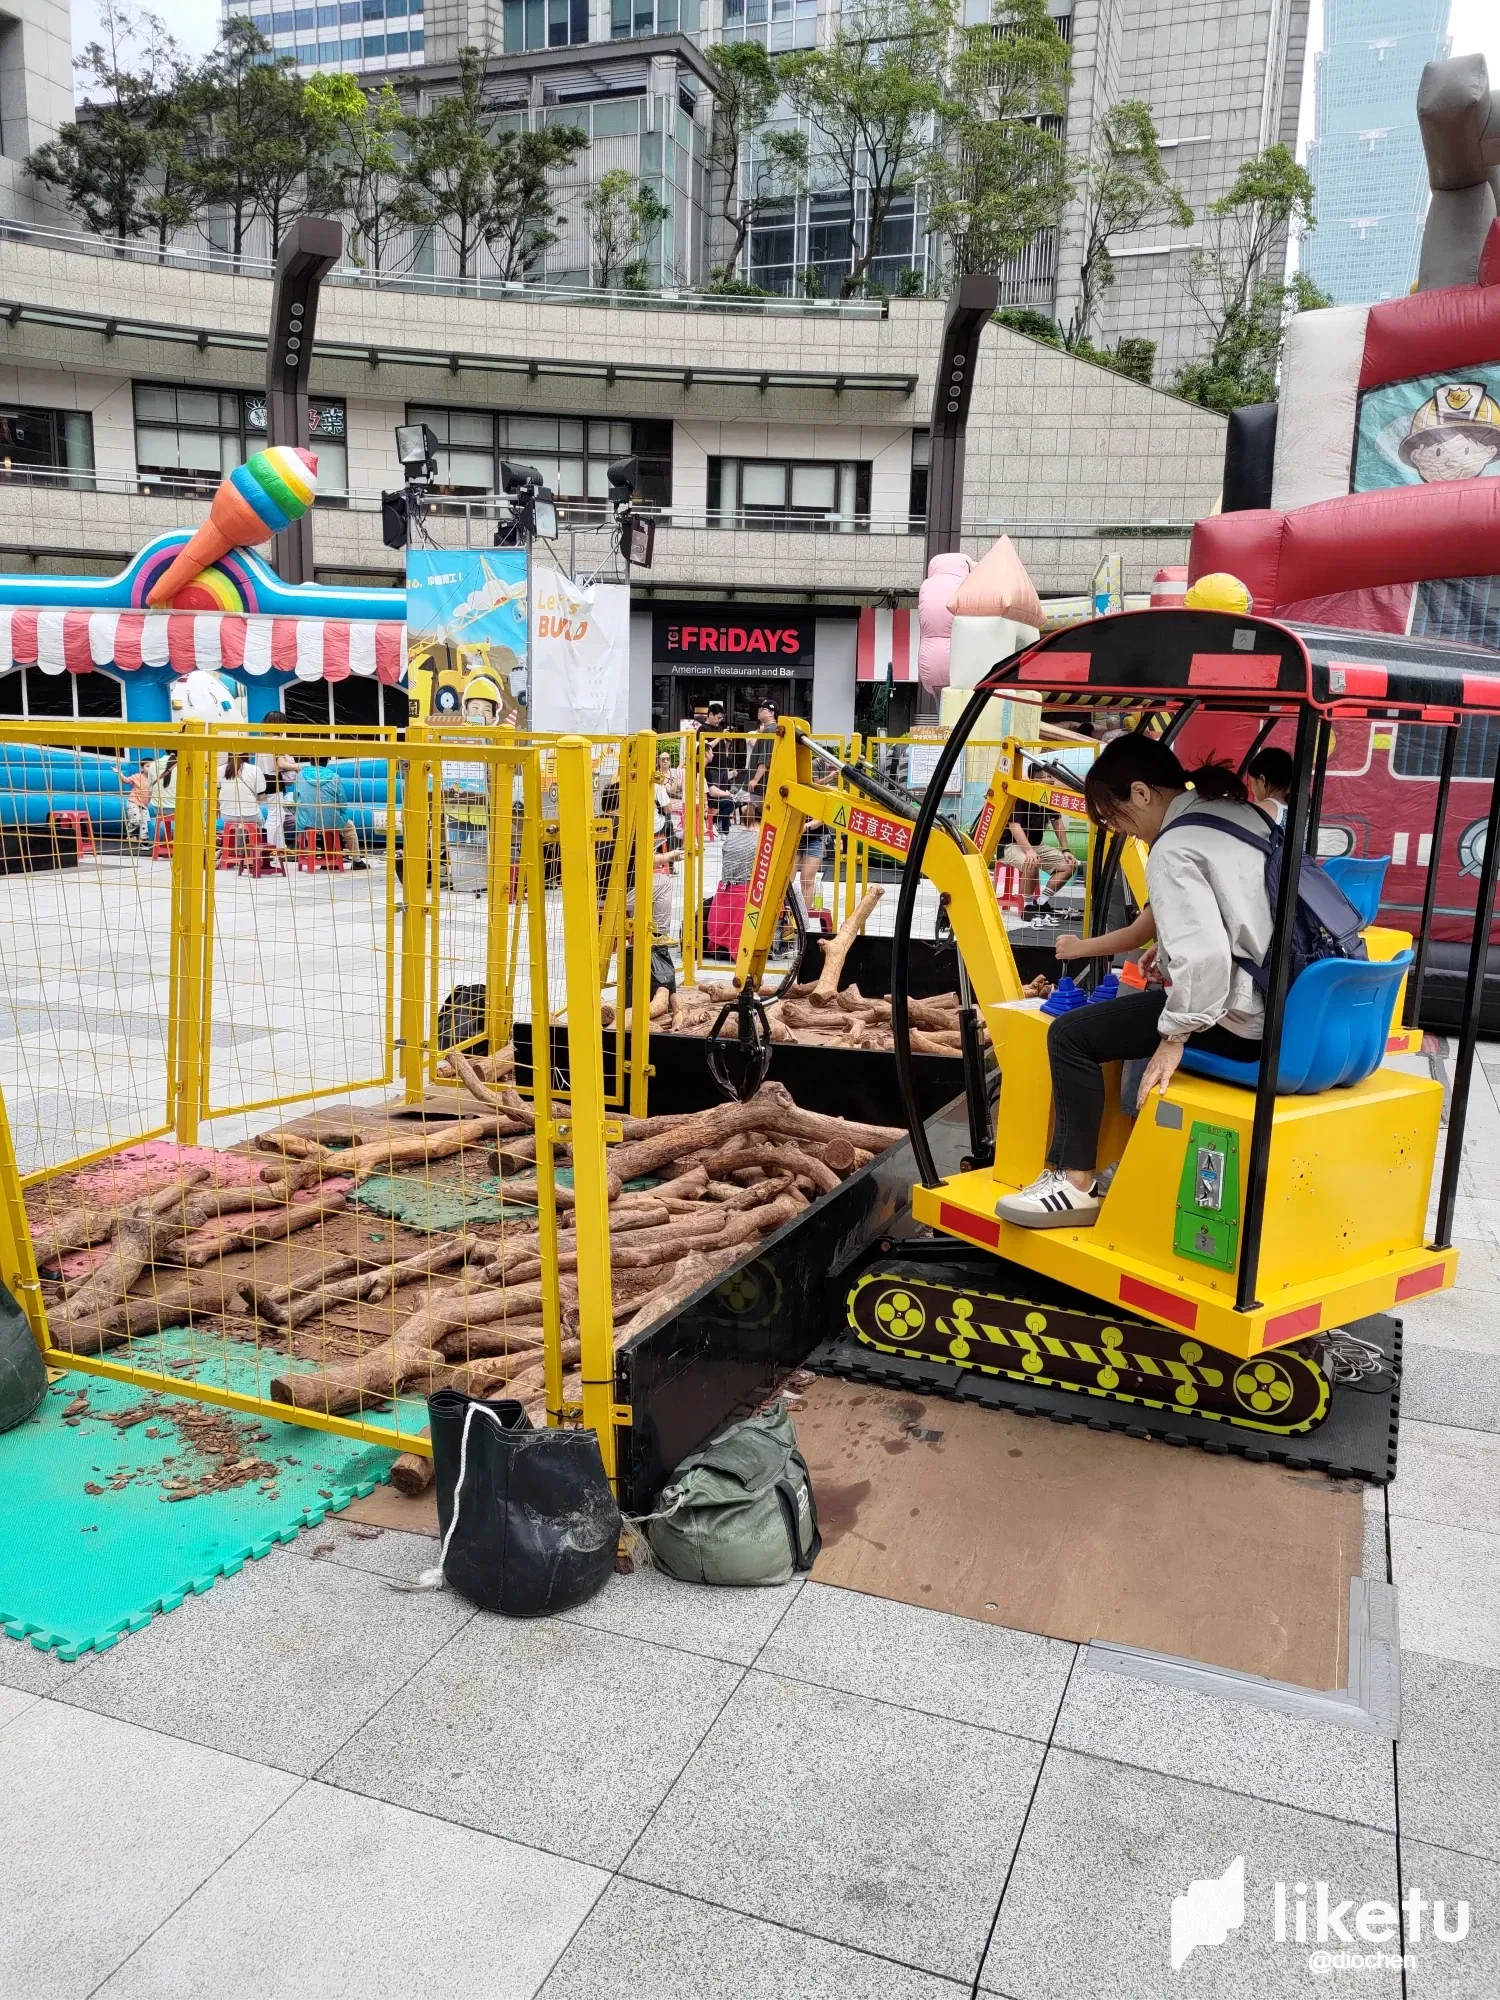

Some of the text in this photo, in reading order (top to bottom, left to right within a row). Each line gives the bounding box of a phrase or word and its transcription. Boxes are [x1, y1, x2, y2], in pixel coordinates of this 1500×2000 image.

[1450, 394, 1467, 403] 342
[668, 626, 679, 650] TGI
[671, 665, 795, 676] American Restaurant and Bar
[850, 811, 909, 849] 注意安全
[752, 830, 775, 903] Caution
